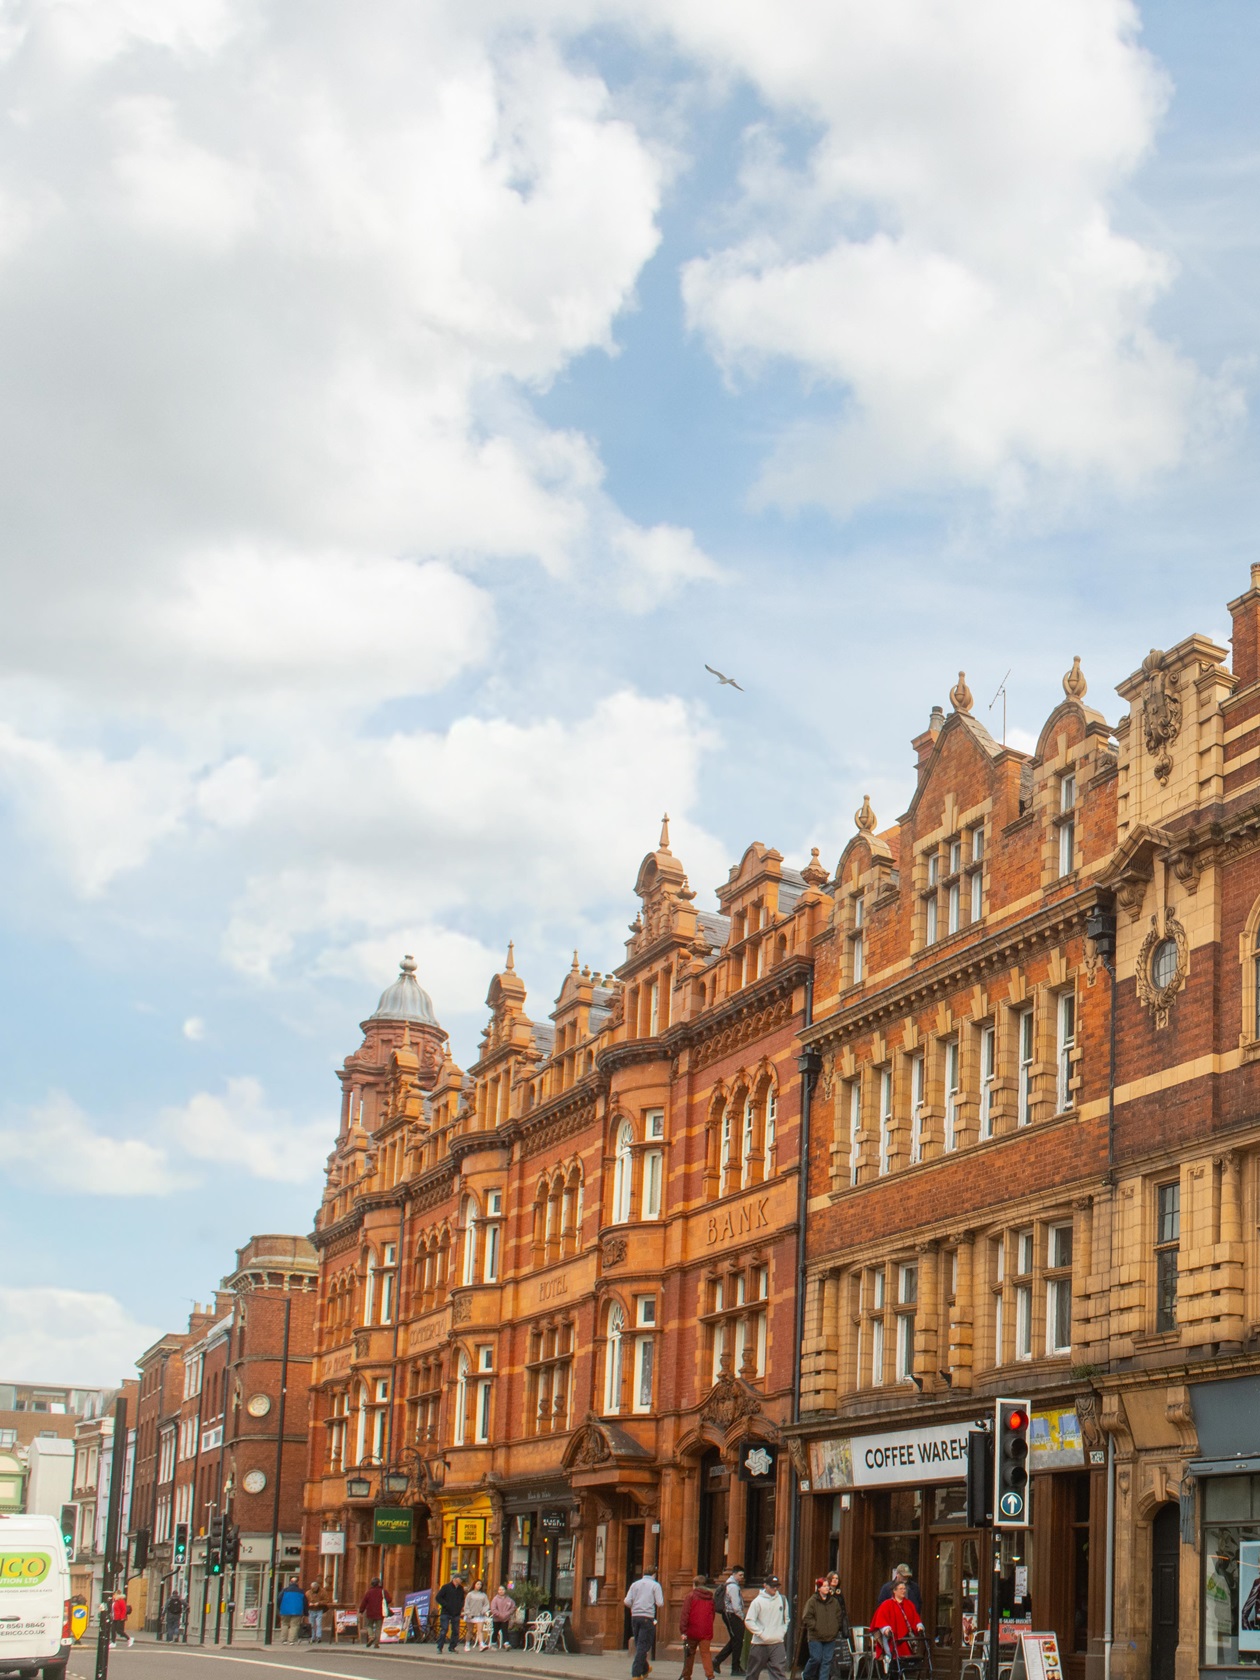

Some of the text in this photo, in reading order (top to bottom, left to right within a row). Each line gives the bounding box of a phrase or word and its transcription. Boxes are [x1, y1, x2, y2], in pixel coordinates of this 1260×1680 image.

[706, 1197, 769, 1246] BANK
[539, 1274, 568, 1302] HOTEL
[865, 1437, 968, 1469] COFFEE WAREH
